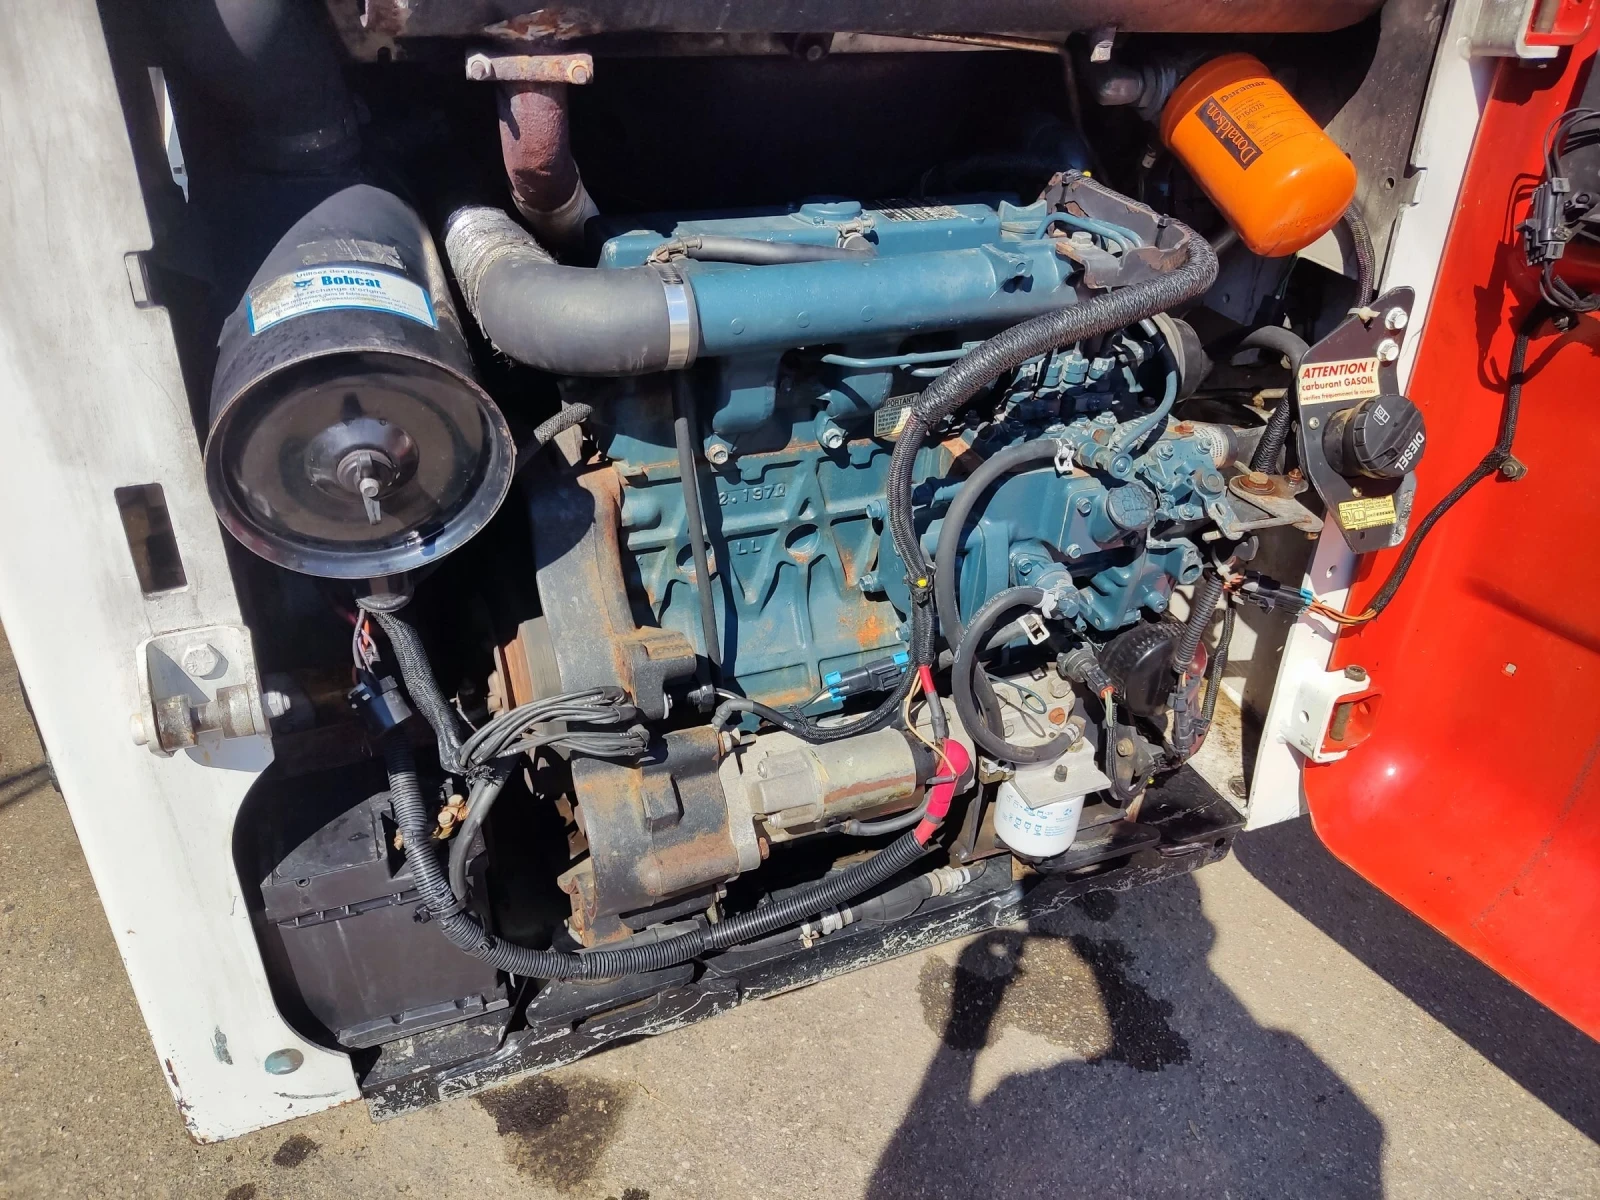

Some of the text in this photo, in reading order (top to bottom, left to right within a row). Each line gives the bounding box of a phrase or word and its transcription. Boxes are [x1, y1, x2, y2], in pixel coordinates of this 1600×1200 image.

[1207, 102, 1258, 164] Donaldson
[321, 275, 382, 289] Bobcat
[1302, 361, 1368, 379] ATTENTION
[1302, 376, 1374, 391] carburant GASOIL
[886, 396, 915, 407] PORTANT
[1394, 431, 1425, 471] DIESEL
